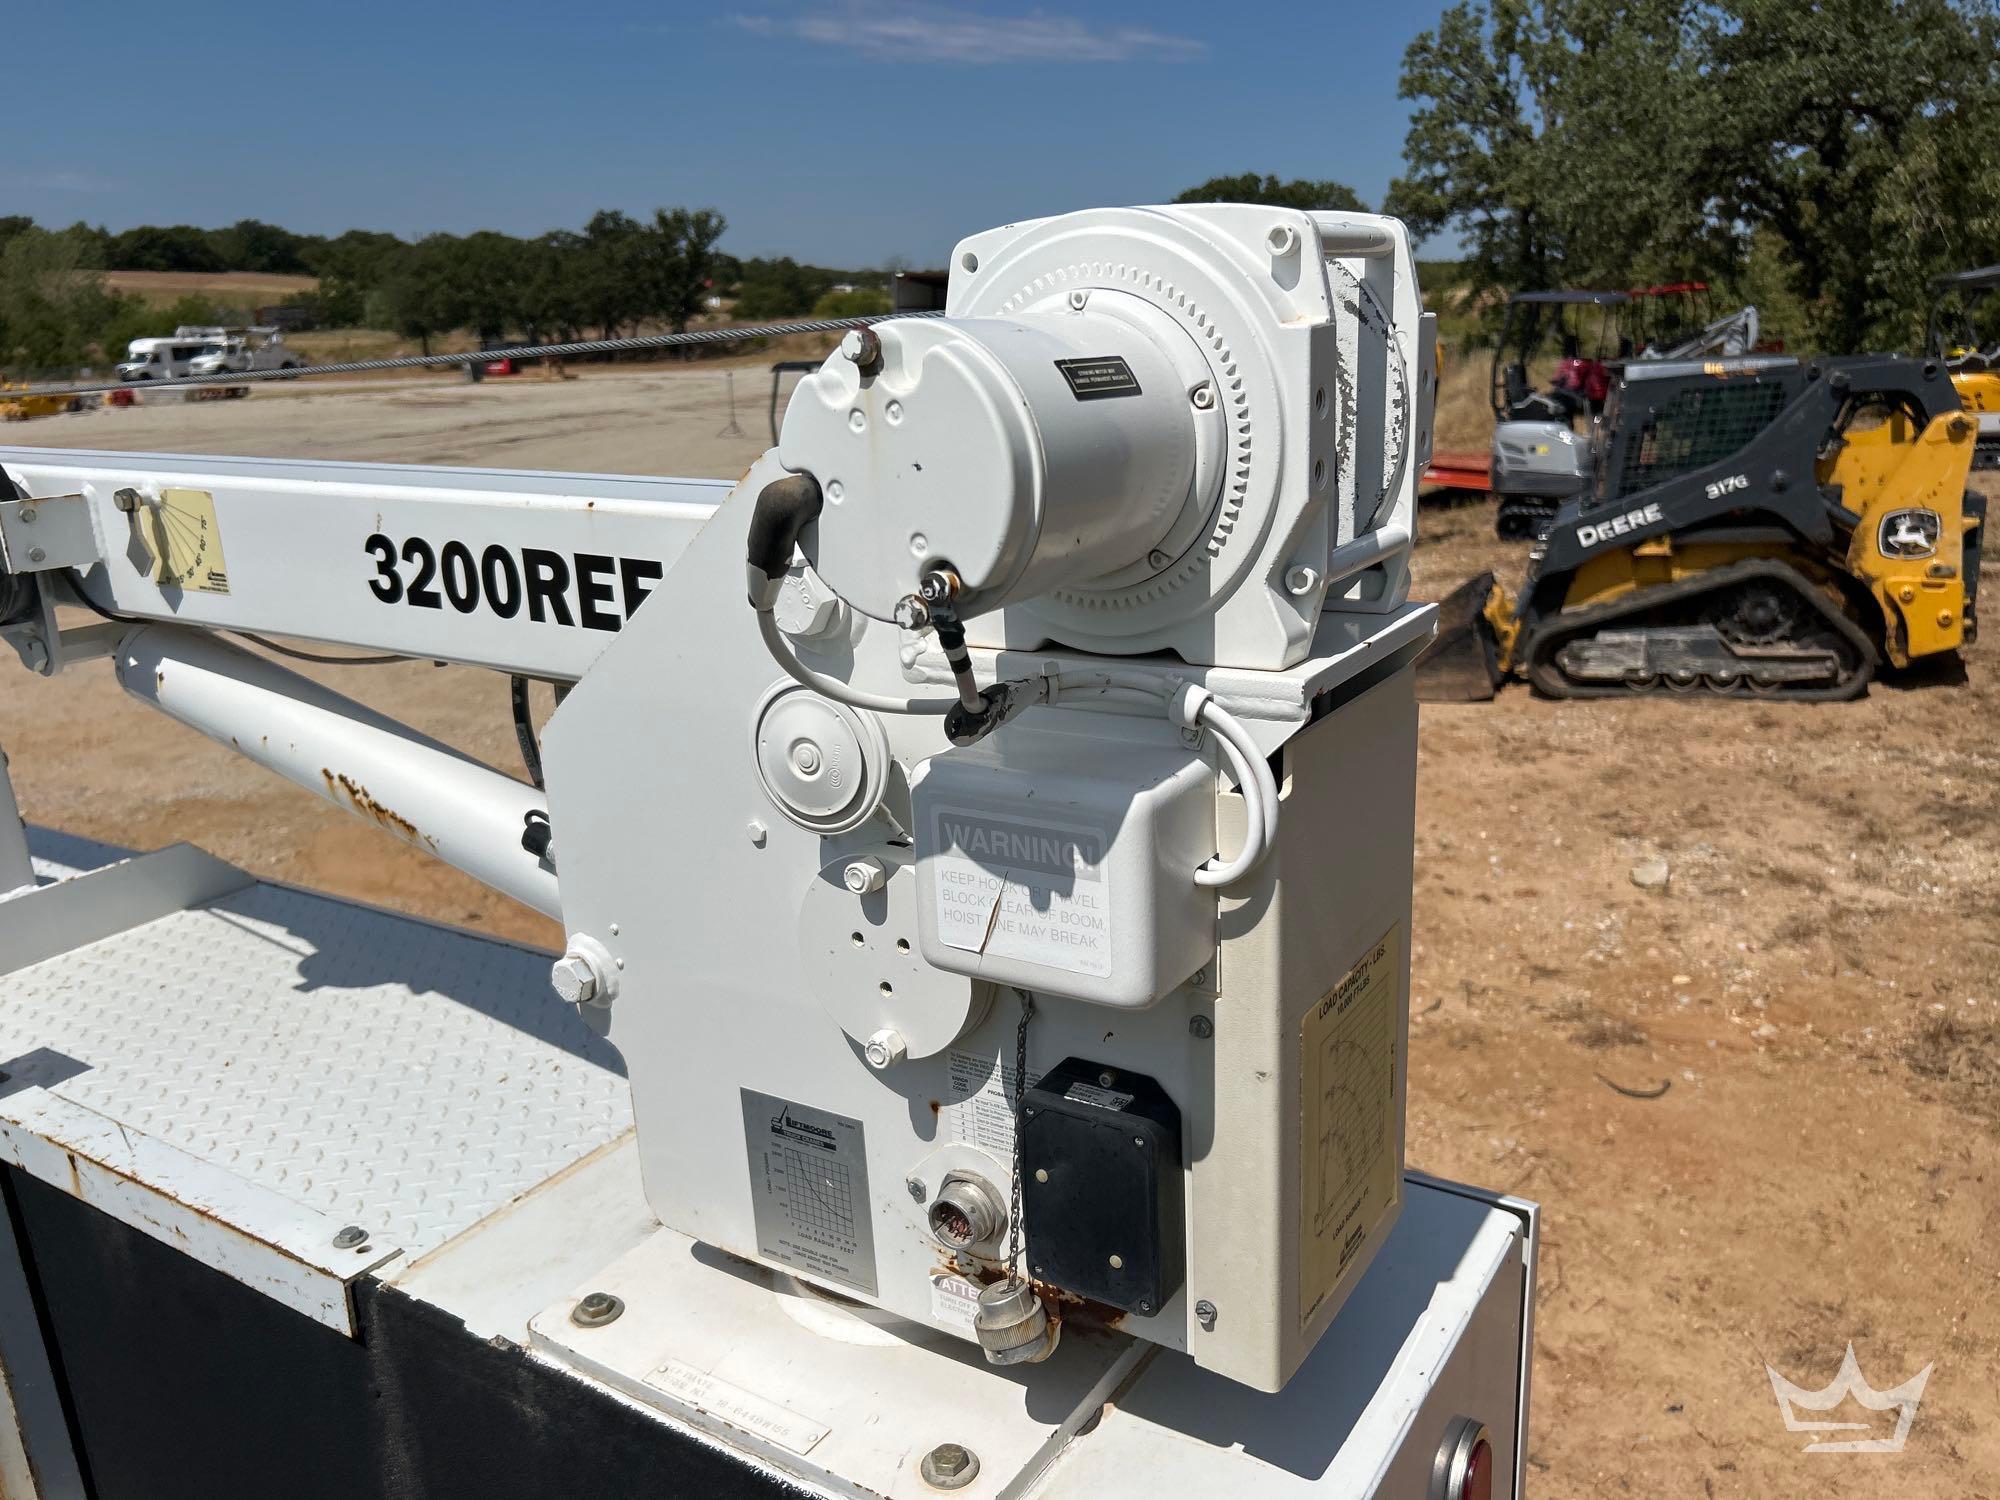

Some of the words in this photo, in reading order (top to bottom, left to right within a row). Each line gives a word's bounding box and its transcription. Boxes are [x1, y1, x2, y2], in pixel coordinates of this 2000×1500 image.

[1704, 474, 1752, 500] 317G
[1576, 502, 1665, 549] DEERE
[941, 869, 975, 886] KEEP
[979, 876, 1018, 895] HOOK
[1022, 885, 1041, 898] OR
[1050, 889, 1100, 909] RAVEL
[943, 890, 986, 908] BLOCK
[990, 897, 1034, 917] CLEAR
[1038, 905, 1057, 920] OF
[944, 907, 983, 926] HOIST
[986, 916, 1017, 933] LNE
[1020, 922, 1047, 937] MAY
[1051, 929, 1098, 950] BREAK
[1319, 993, 1338, 1020] LOAD
[1338, 959, 1369, 1000] CAPACITY
[786, 1116, 834, 1138] LIFTMOORE
